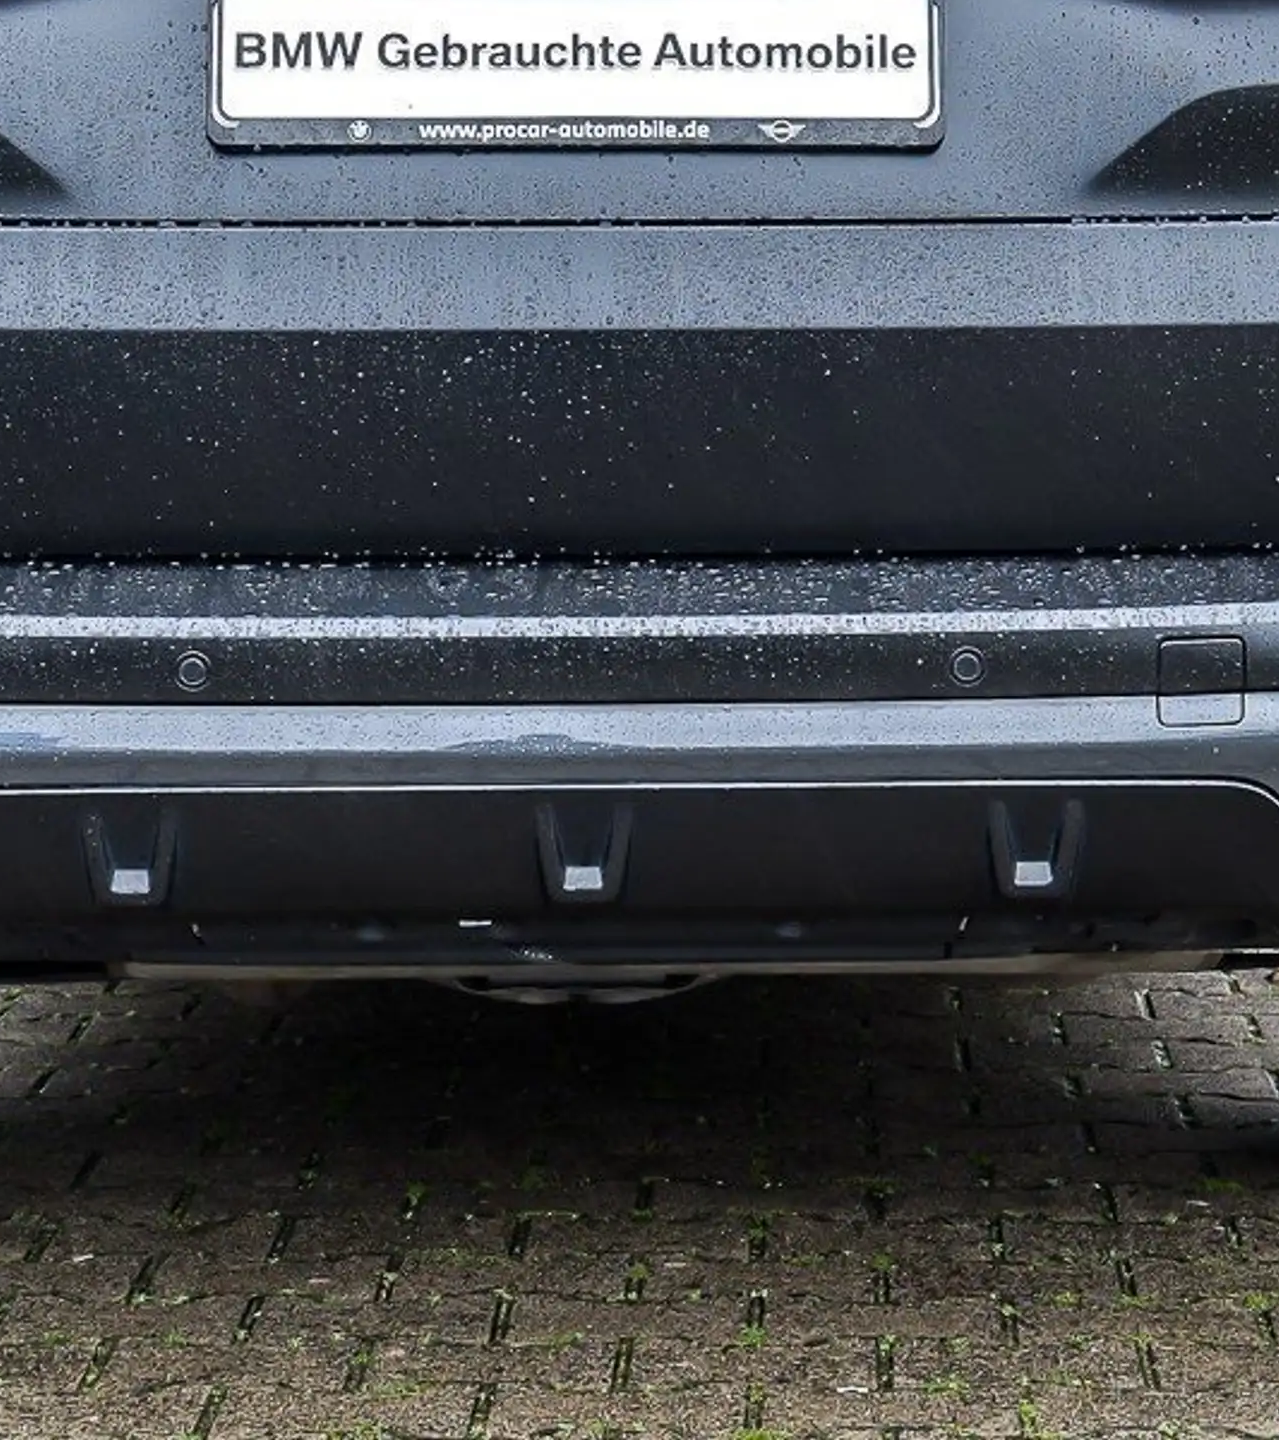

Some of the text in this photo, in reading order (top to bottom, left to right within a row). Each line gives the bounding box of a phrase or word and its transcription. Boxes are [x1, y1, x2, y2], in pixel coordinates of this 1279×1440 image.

[234, 31, 917, 68] BMW Gebrauchte Automobile
[418, 120, 710, 143] www.procar-automobile.de
